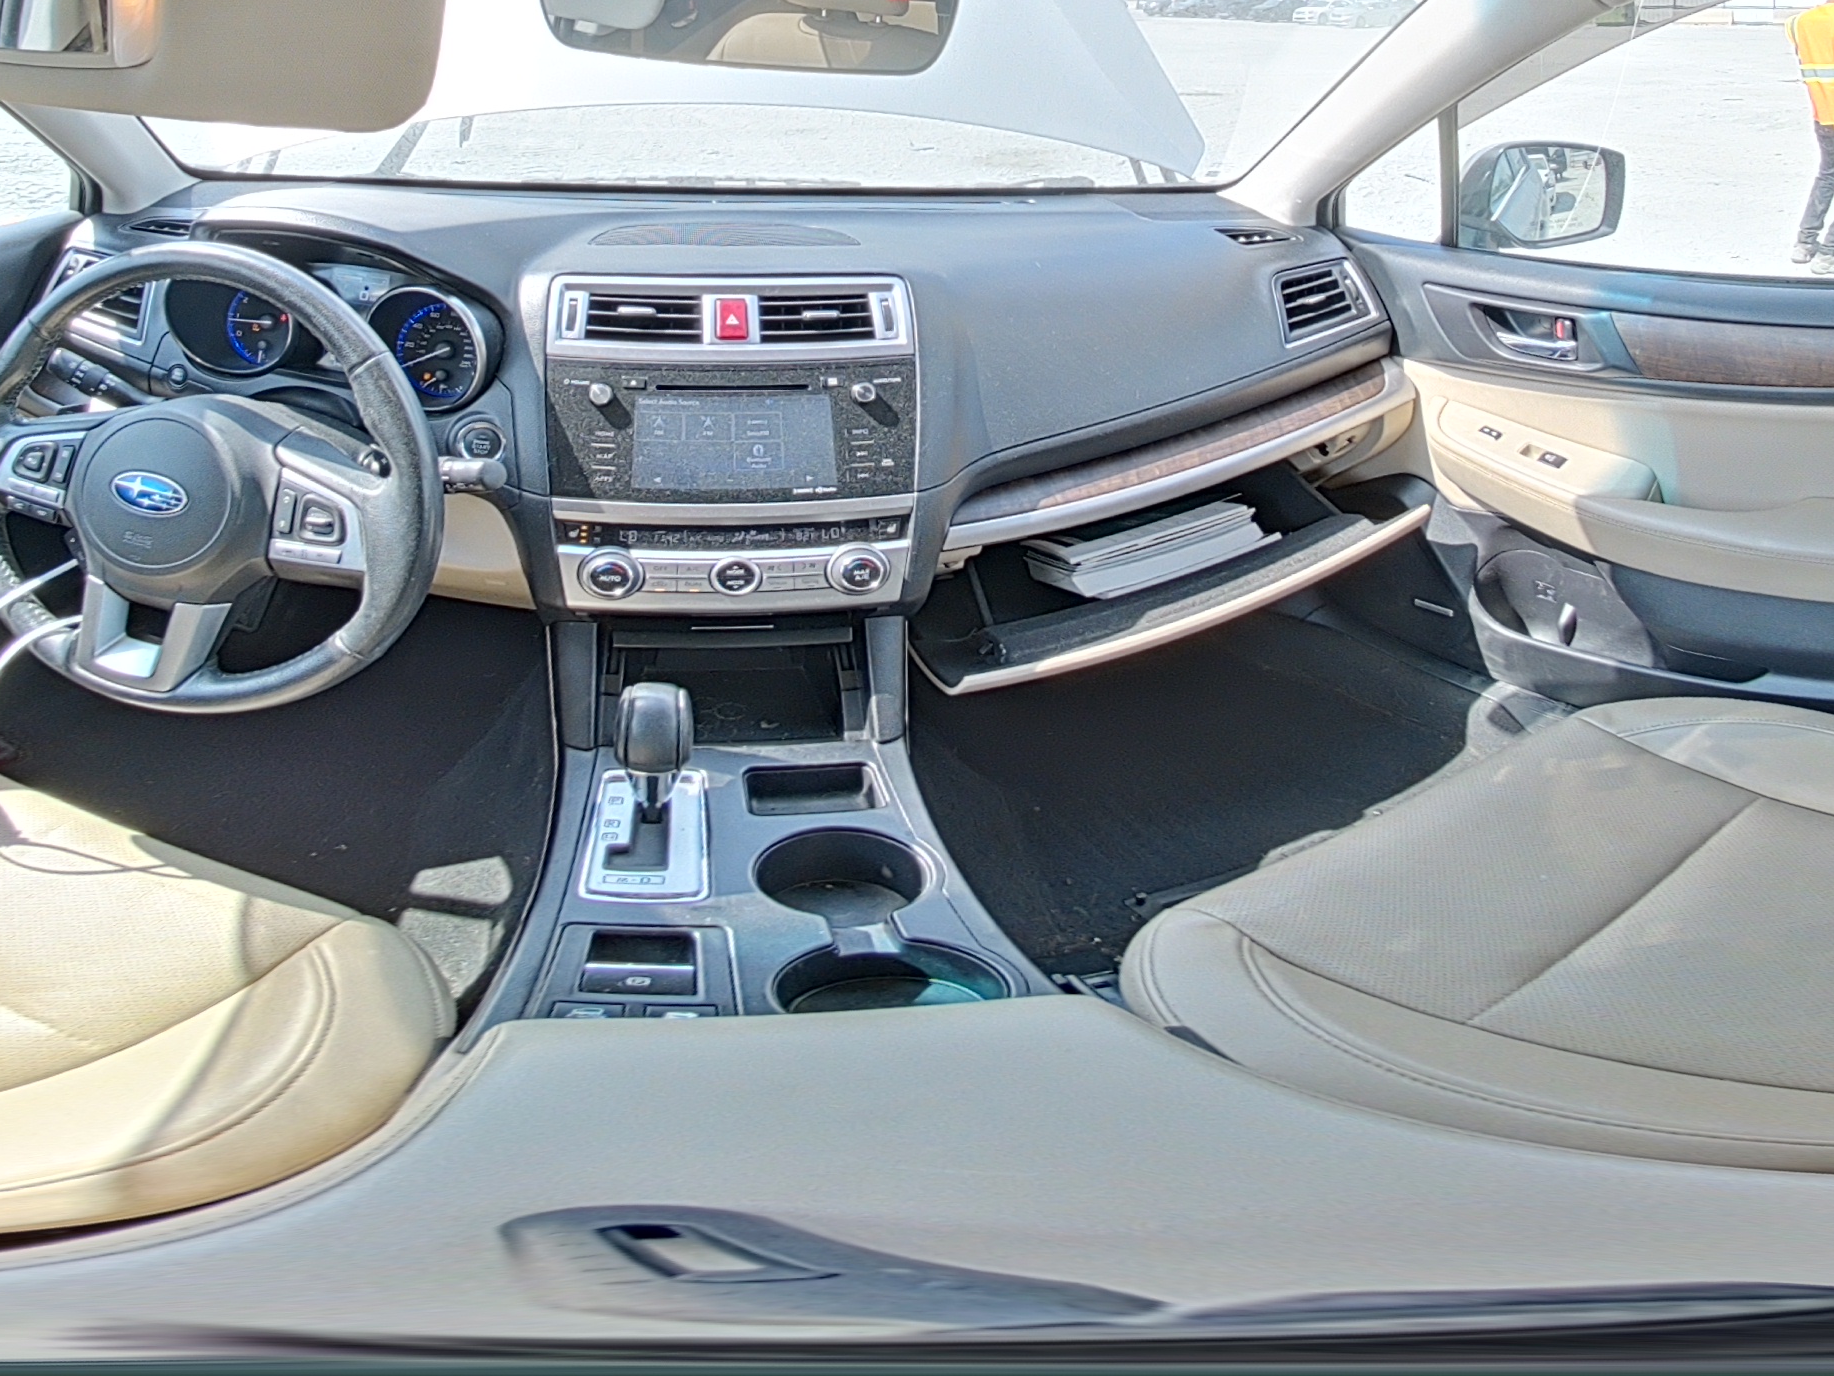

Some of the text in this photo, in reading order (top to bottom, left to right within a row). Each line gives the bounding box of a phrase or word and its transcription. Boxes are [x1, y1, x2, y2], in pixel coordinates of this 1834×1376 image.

[659, 398, 678, 406] Audio
[678, 398, 701, 407] Source
[597, 575, 622, 583] AUTO
